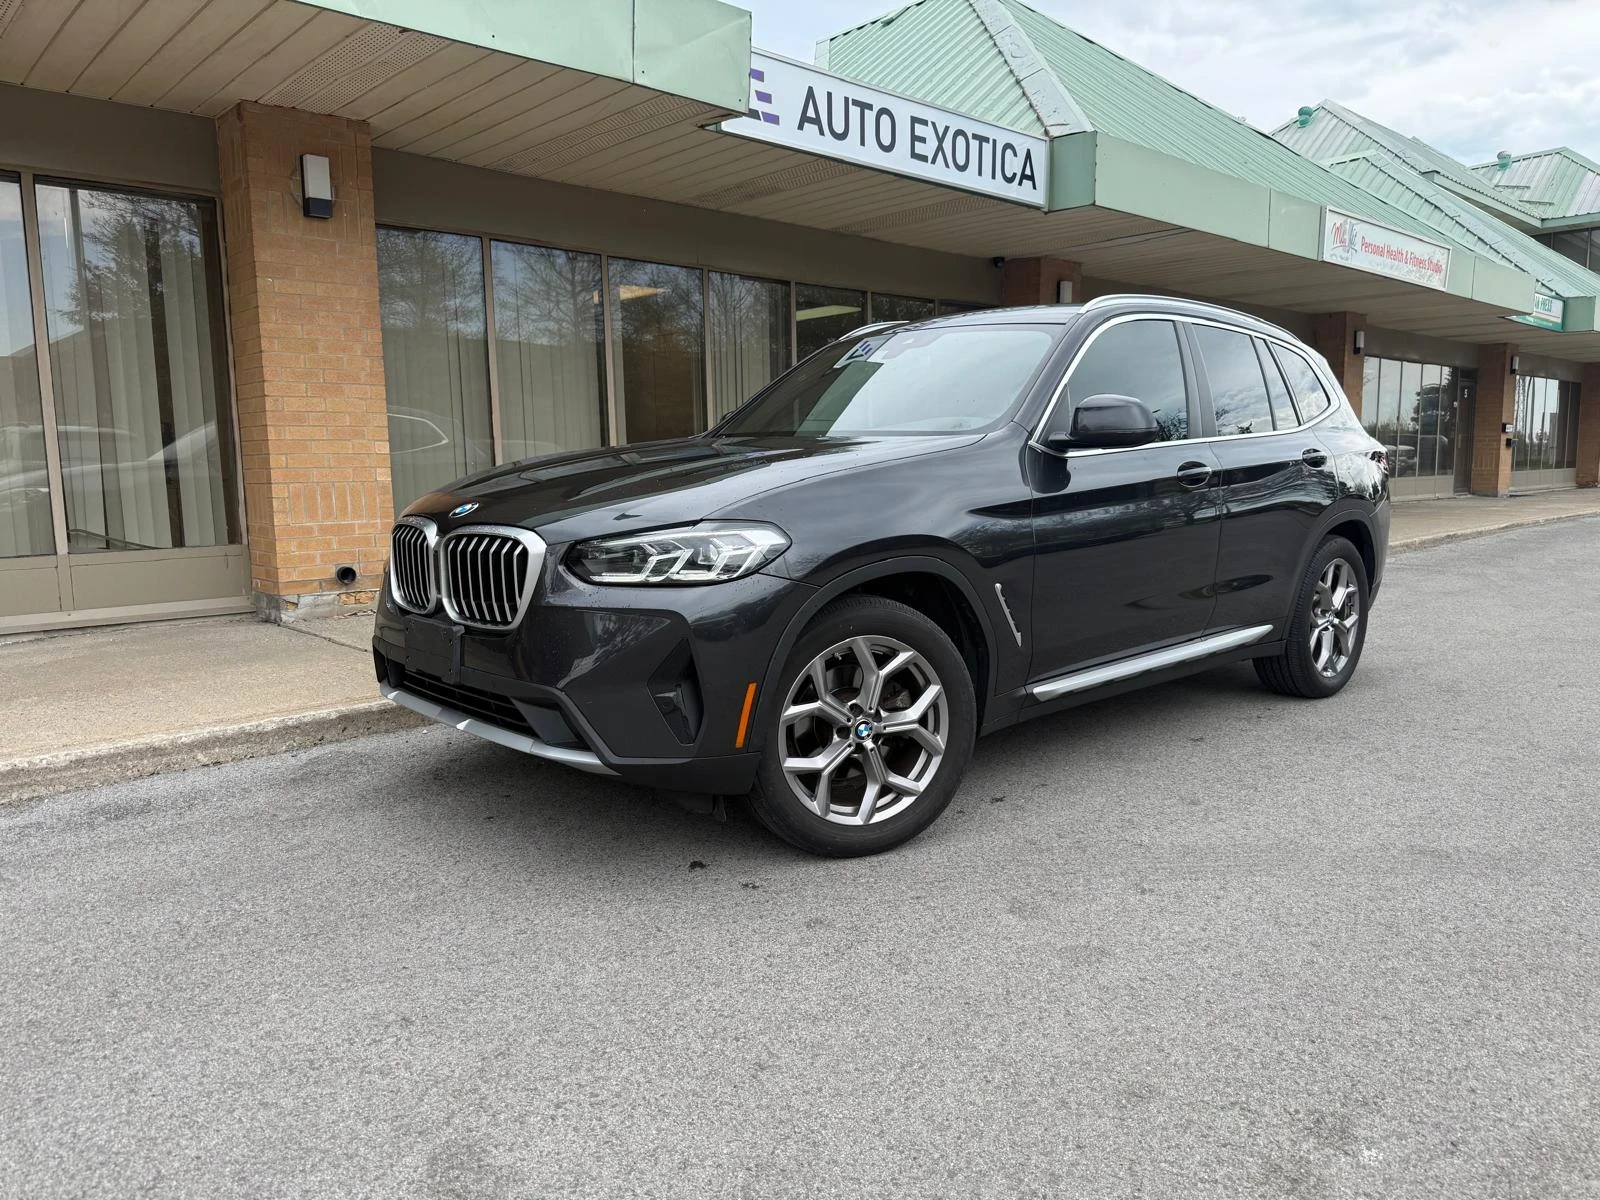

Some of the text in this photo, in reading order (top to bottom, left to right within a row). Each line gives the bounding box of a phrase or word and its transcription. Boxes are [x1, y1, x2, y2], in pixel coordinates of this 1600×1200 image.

[798, 85, 896, 153] AUTO
[910, 115, 1037, 190] EXOTICA
[1361, 236, 1385, 257] Personal
[1386, 245, 1404, 263] Health
[1404, 250, 1409, 264] &
[1409, 251, 1427, 269] Fitness
[1427, 256, 1443, 273] Studio
